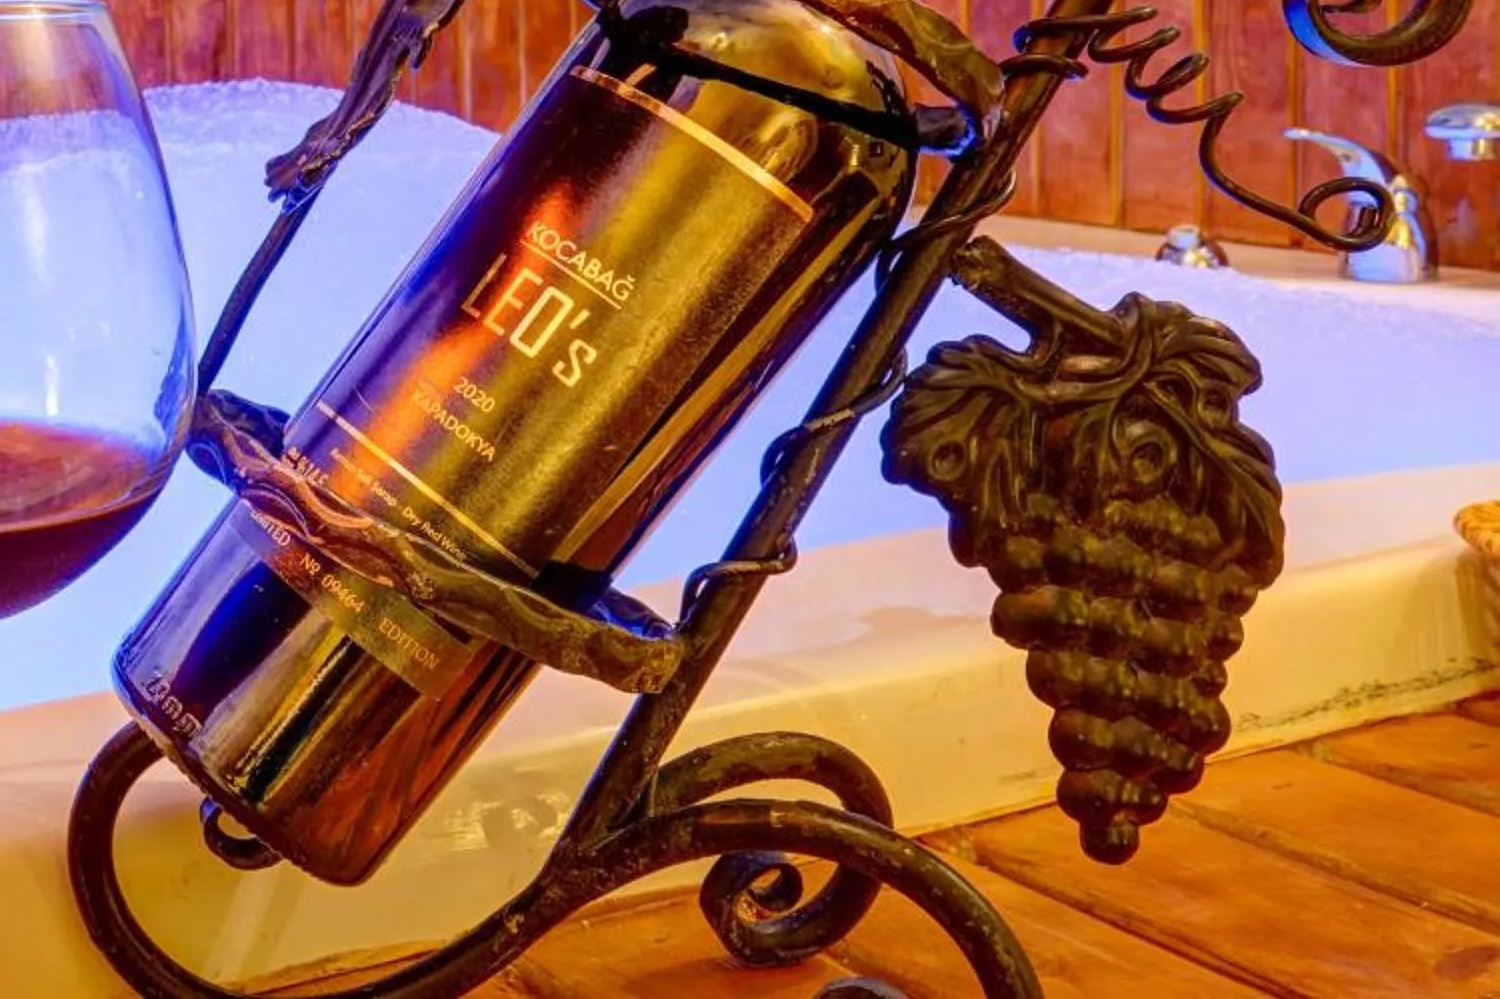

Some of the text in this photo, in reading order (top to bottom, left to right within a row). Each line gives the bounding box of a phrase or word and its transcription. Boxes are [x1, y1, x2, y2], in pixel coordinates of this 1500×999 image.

[526, 220, 637, 301] KOCABAĞ
[453, 376, 496, 413] 2020
[410, 389, 496, 462] KAPADOKYA
[402, 505, 422, 526] Dry
[378, 616, 440, 670] EDITION
